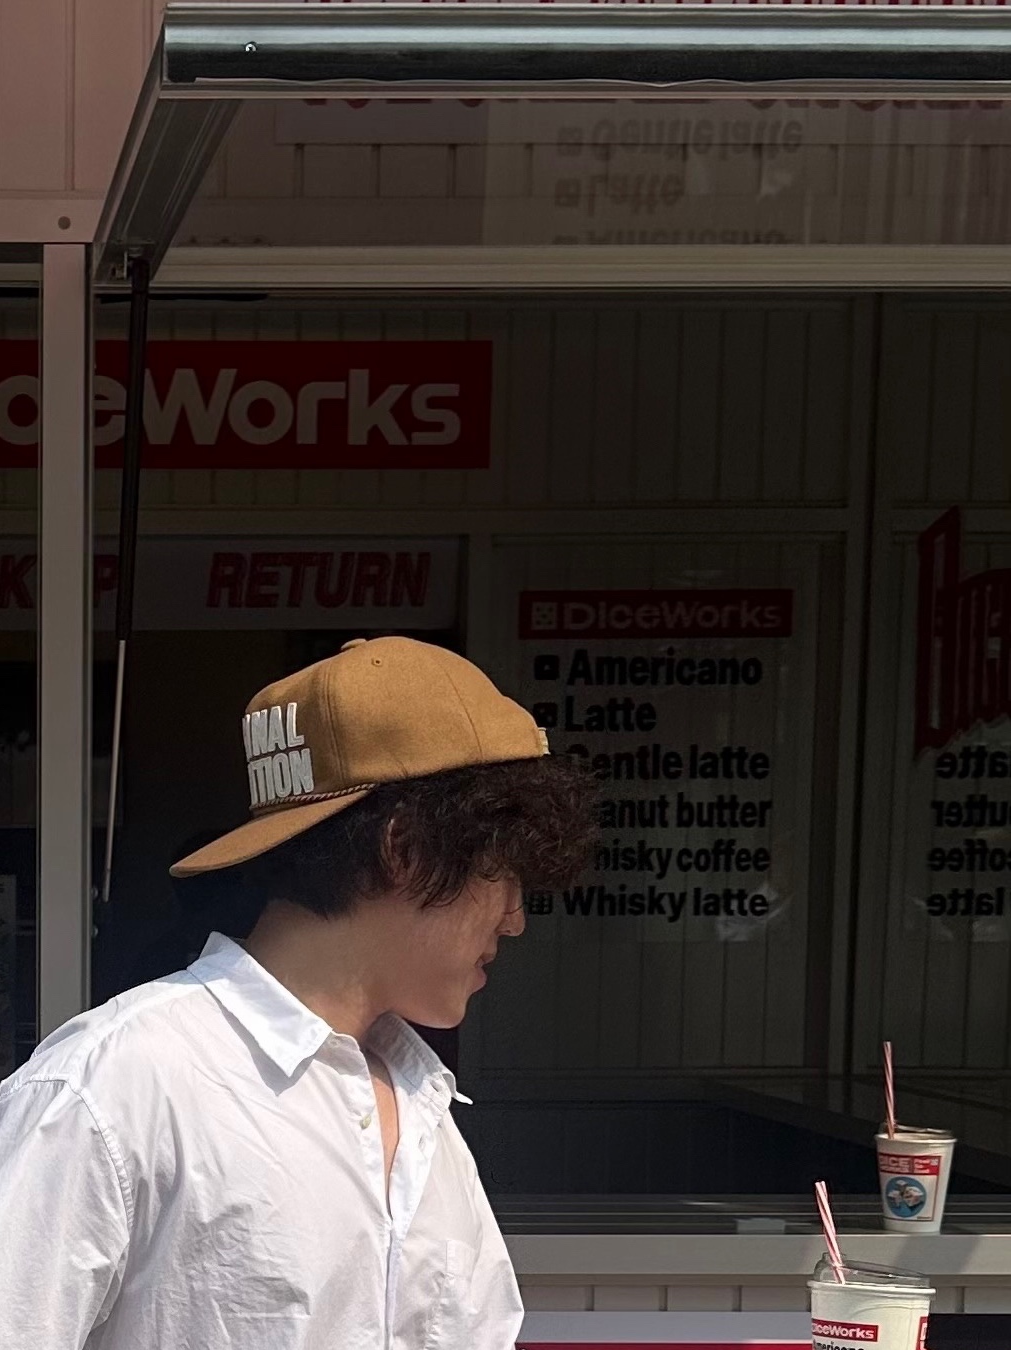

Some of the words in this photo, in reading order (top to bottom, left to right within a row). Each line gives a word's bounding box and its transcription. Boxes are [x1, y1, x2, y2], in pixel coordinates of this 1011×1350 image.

[207, 551, 430, 608] RETURN
[567, 647, 763, 686] Americano
[565, 695, 658, 732] Latte
[567, 743, 683, 780] entle
[689, 743, 771, 780] latte
[599, 794, 669, 829] anut
[676, 792, 773, 828] butter
[676, 839, 771, 872] coffee
[563, 884, 688, 923] Whisky
[693, 887, 770, 917] latte
